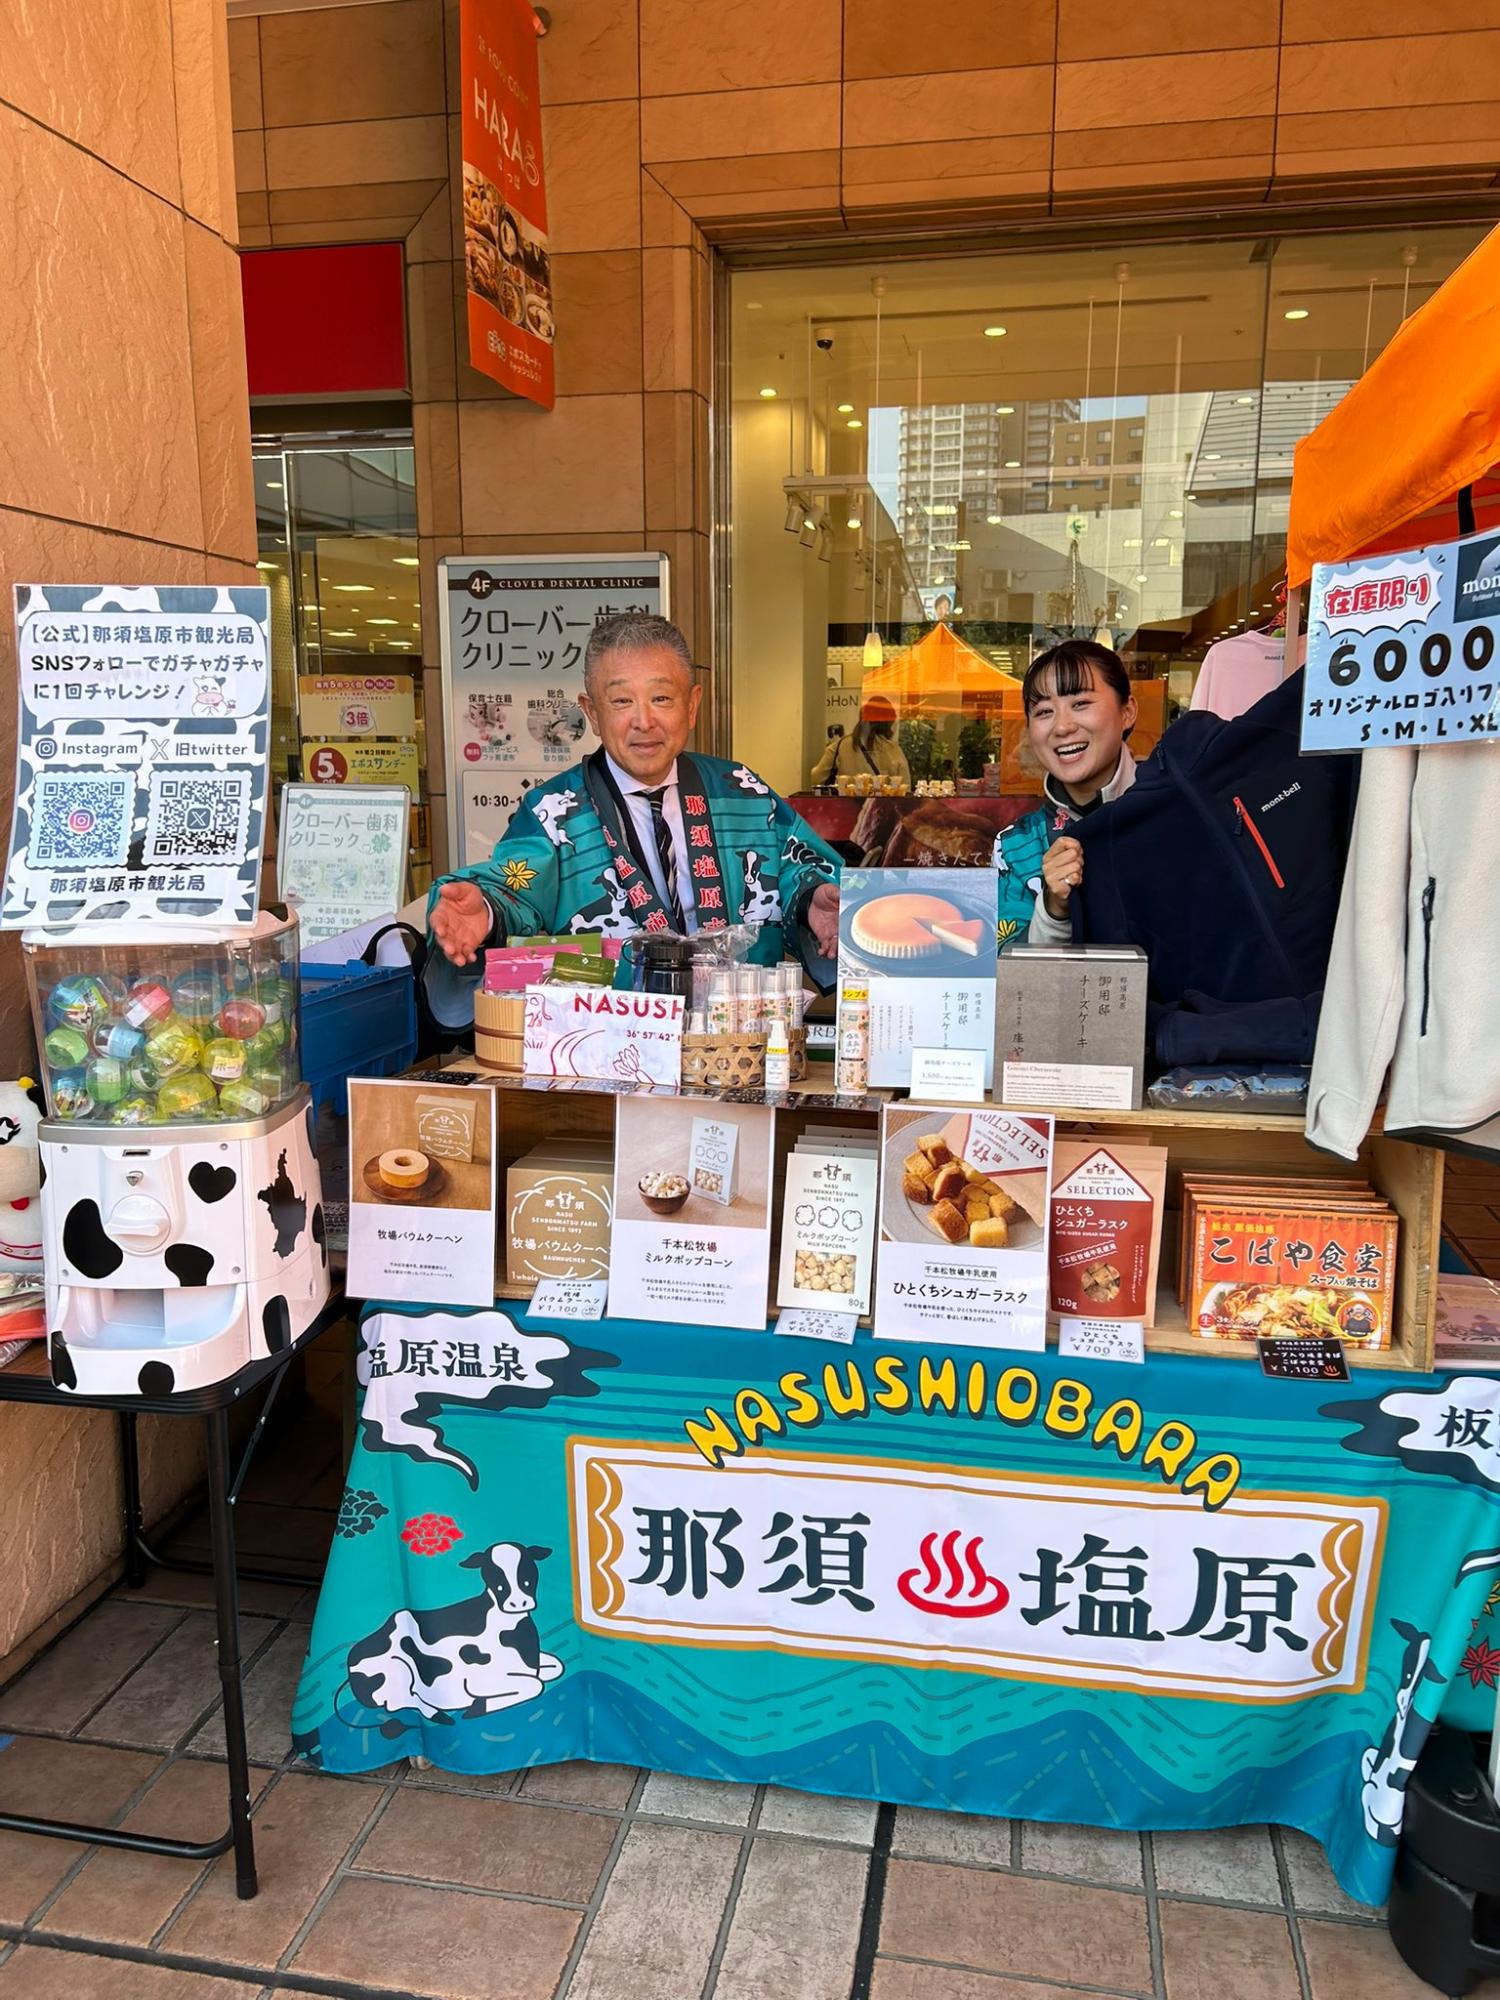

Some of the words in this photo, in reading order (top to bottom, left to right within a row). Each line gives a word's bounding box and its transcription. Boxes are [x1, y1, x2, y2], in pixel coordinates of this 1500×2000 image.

[471, 577, 491, 592] 4F
[499, 580, 545, 589] CLOVER
[550, 579, 596, 588] DENTAL
[602, 578, 644, 587] CLINIC
[1326, 574, 1431, 617] 在庫限り
[31, 624, 255, 645] 【公式】那須塩原市観光局
[31, 655, 263, 674] SNSフォローでガチャガチャ
[463, 642, 582, 670] クリニック
[1328, 625, 1494, 687] 6000
[1309, 683, 1500, 717] オリジナルロゴ入りフ
[346, 712, 368, 725] 3倍
[62, 742, 138, 759] Instagram
[175, 742, 248, 757] 旧twitter
[351, 758, 406, 769] エポスサンデー
[292, 812, 398, 832] クローバー歯科
[290, 831, 359, 849] クリニック
[50, 875, 206, 894] 那須塩原市観光局
[1099, 976, 1111, 1016] 御用邸
[1077, 975, 1090, 1049] チーズケーキ
[1067, 1186, 1135, 1195] SELECTION
[1056, 1206, 1094, 1216] ひとくち
[1056, 1218, 1128, 1230] シュガーラスク
[378, 1229, 463, 1244] 牧場バウムクーヘン
[662, 1239, 717, 1252] 千本松牧場
[797, 1231, 858, 1243] ミルクポップコーン
[512, 1237, 610, 1255] 牧場バウムクーヘ
[1210, 1236, 1384, 1274] こばや食堂
[645, 1252, 733, 1268] ミルクポップコーン
[1310, 1275, 1377, 1288] スープ入り焼そば
[894, 1282, 1028, 1304] ひとくちシュガーラスク
[1057, 1298, 1078, 1309] 120g
[683, 1356, 1242, 1512] NASUSHIOBARA
[1434, 1405, 1500, 1457] 板
